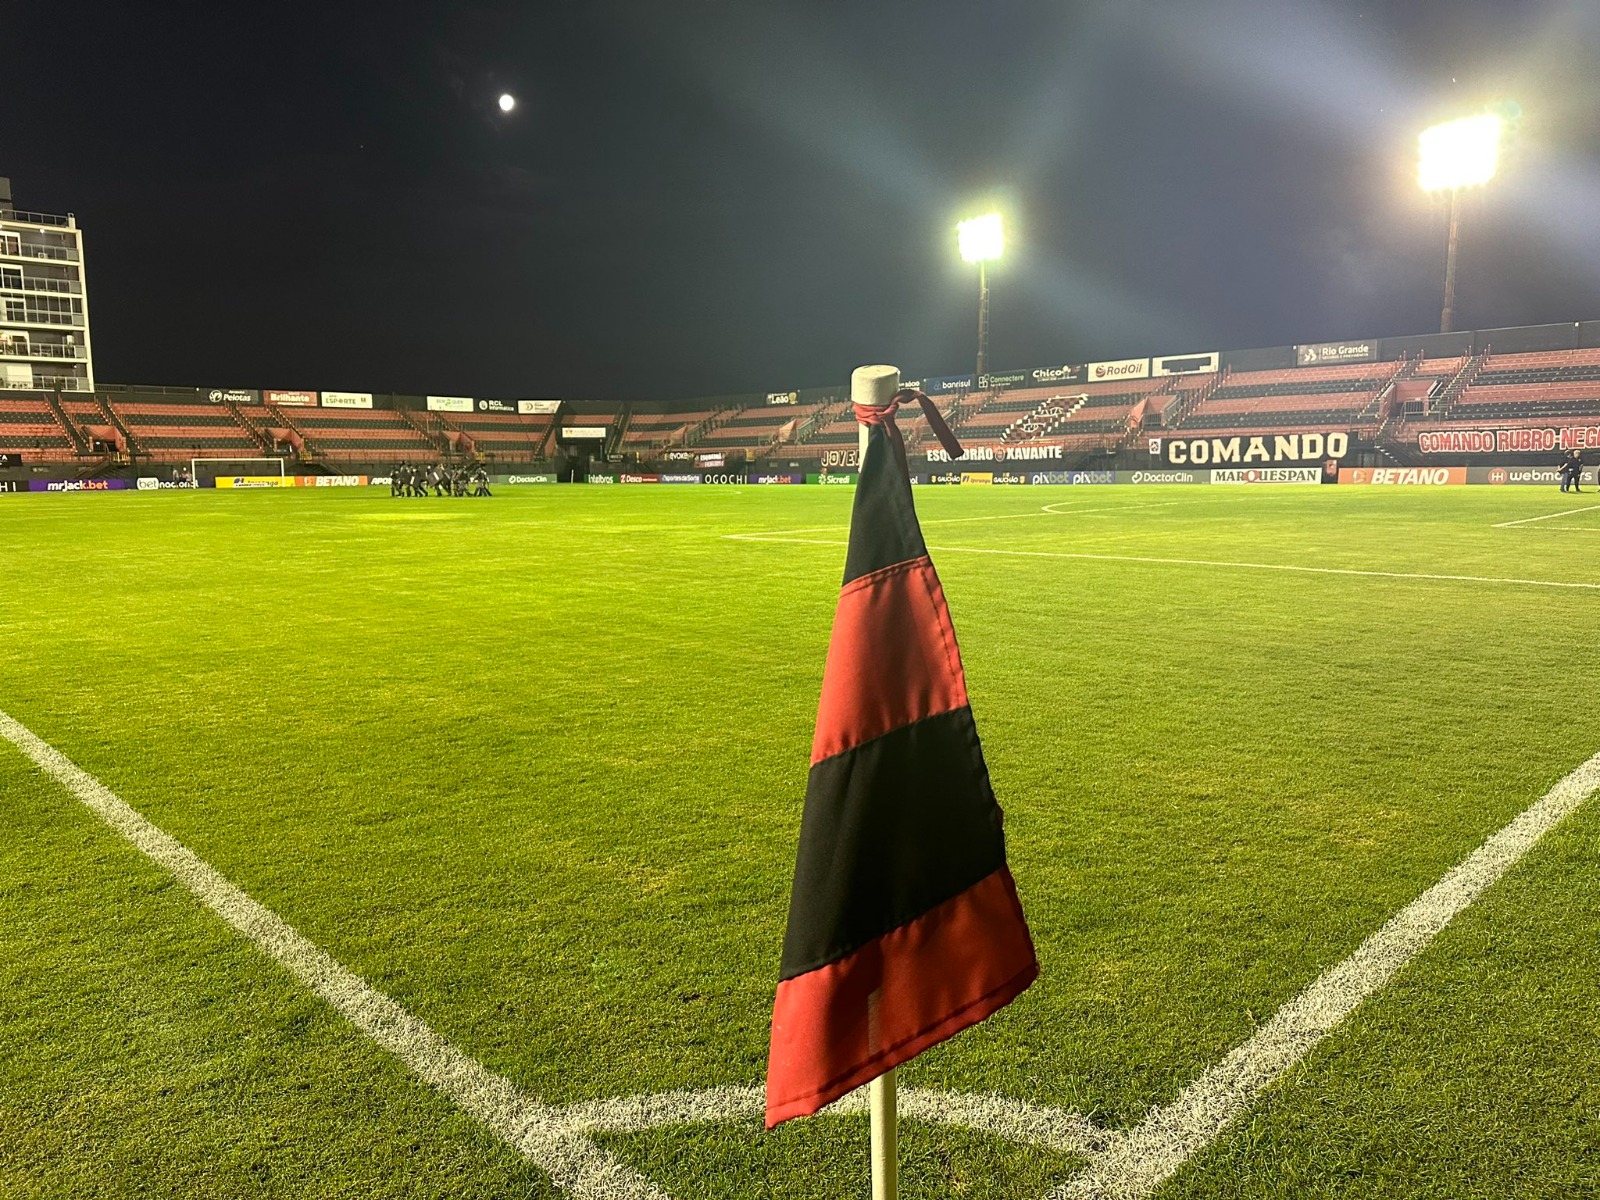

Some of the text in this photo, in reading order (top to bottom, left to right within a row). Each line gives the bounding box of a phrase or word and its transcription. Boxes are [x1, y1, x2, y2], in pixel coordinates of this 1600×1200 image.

[1322, 347, 1337, 356] Rio
[1338, 344, 1369, 354] Grande
[1032, 369, 1062, 378] Chico
[1106, 363, 1142, 375] RodOil
[942, 379, 971, 388] banrisul
[223, 394, 251, 402] Pelotas
[1419, 426, 1600, 453] COMANDO RUBRO-NEG
[926, 446, 1063, 462] ESQDRÃO XAVANTE
[1168, 432, 1349, 464] COMANDO
[316, 475, 359, 486] BETANO
[516, 475, 548, 484] DoctorClin
[704, 474, 747, 484] OGOCHI
[826, 475, 850, 484] Sicredi
[1032, 472, 1069, 485] pixbet
[1073, 471, 1112, 485] pixbet
[1143, 472, 1193, 482] DoctorClin
[1371, 469, 1449, 485] BETANO
[1509, 469, 1593, 482] webmors
